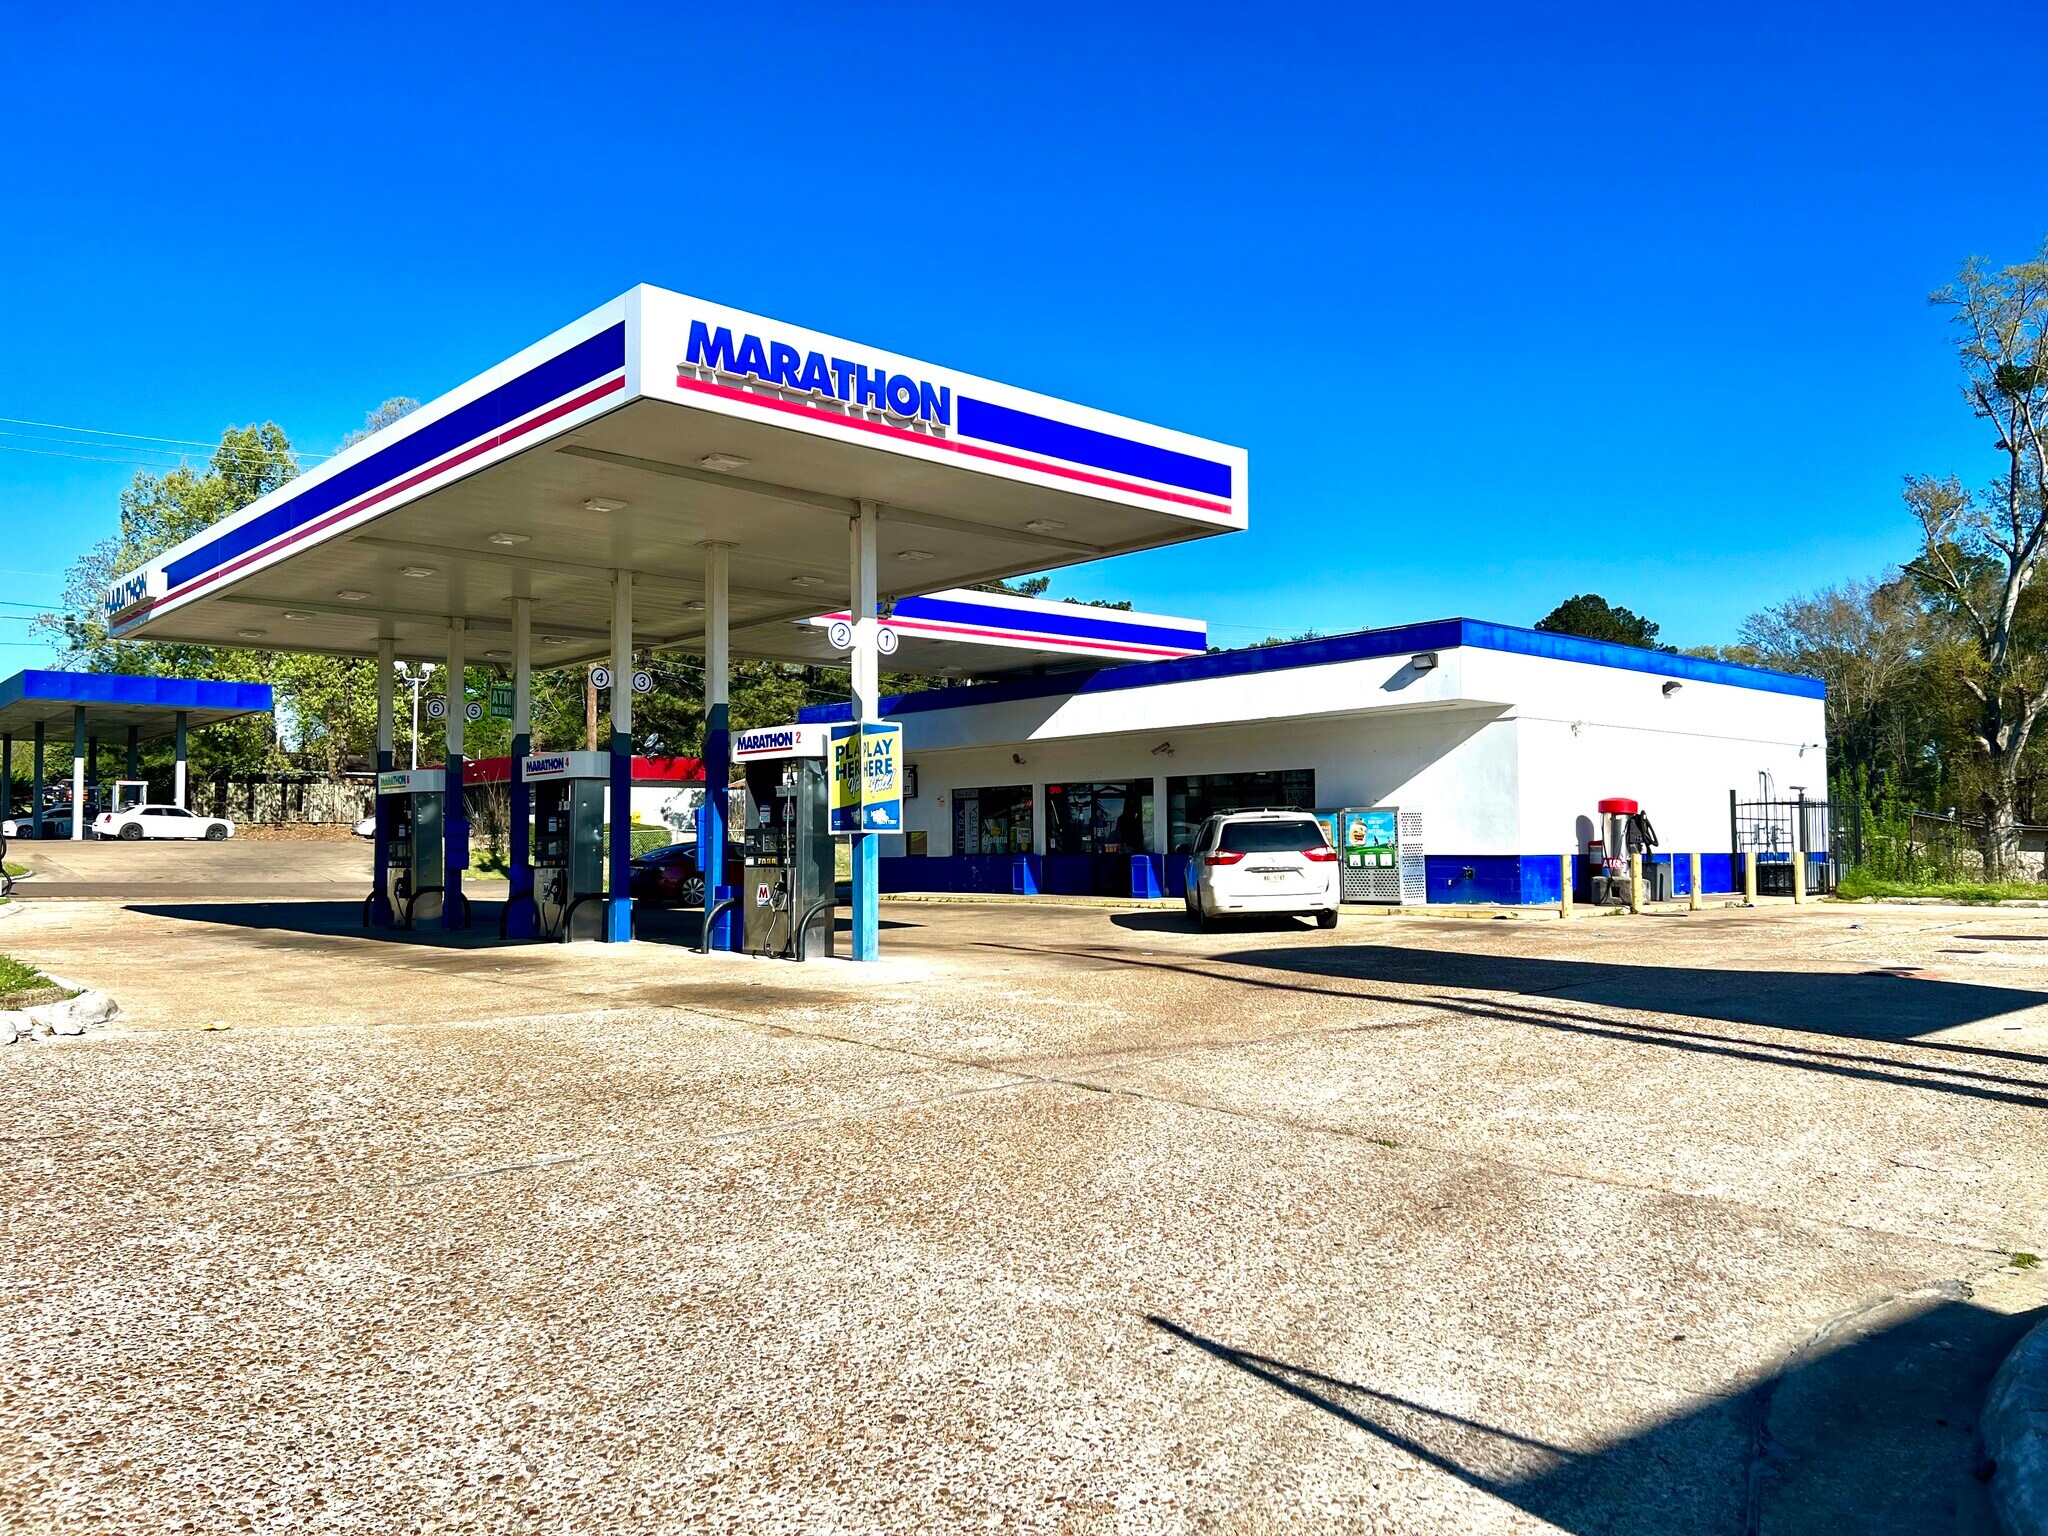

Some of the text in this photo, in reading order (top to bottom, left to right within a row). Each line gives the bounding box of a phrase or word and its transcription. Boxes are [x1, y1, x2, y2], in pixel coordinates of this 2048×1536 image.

[685, 319, 951, 427] MARATHON
[837, 628, 845, 641] 2
[885, 634, 889, 646] 1
[596, 672, 604, 683] 4
[638, 676, 646, 687] 3
[492, 690, 512, 705] ATM
[432, 703, 440, 713] 6
[470, 706, 478, 716] 5
[491, 706, 512, 715] INSIDE
[737, 731, 802, 751] MARATHON 2
[835, 742, 861, 763] PLA
[863, 738, 893, 758] PLAY
[526, 757, 570, 773] MARATHON 4
[835, 759, 861, 781] HER
[863, 757, 893, 777] HERE
[984, 834, 1007, 845] Corona
[758, 887, 768, 898] M
